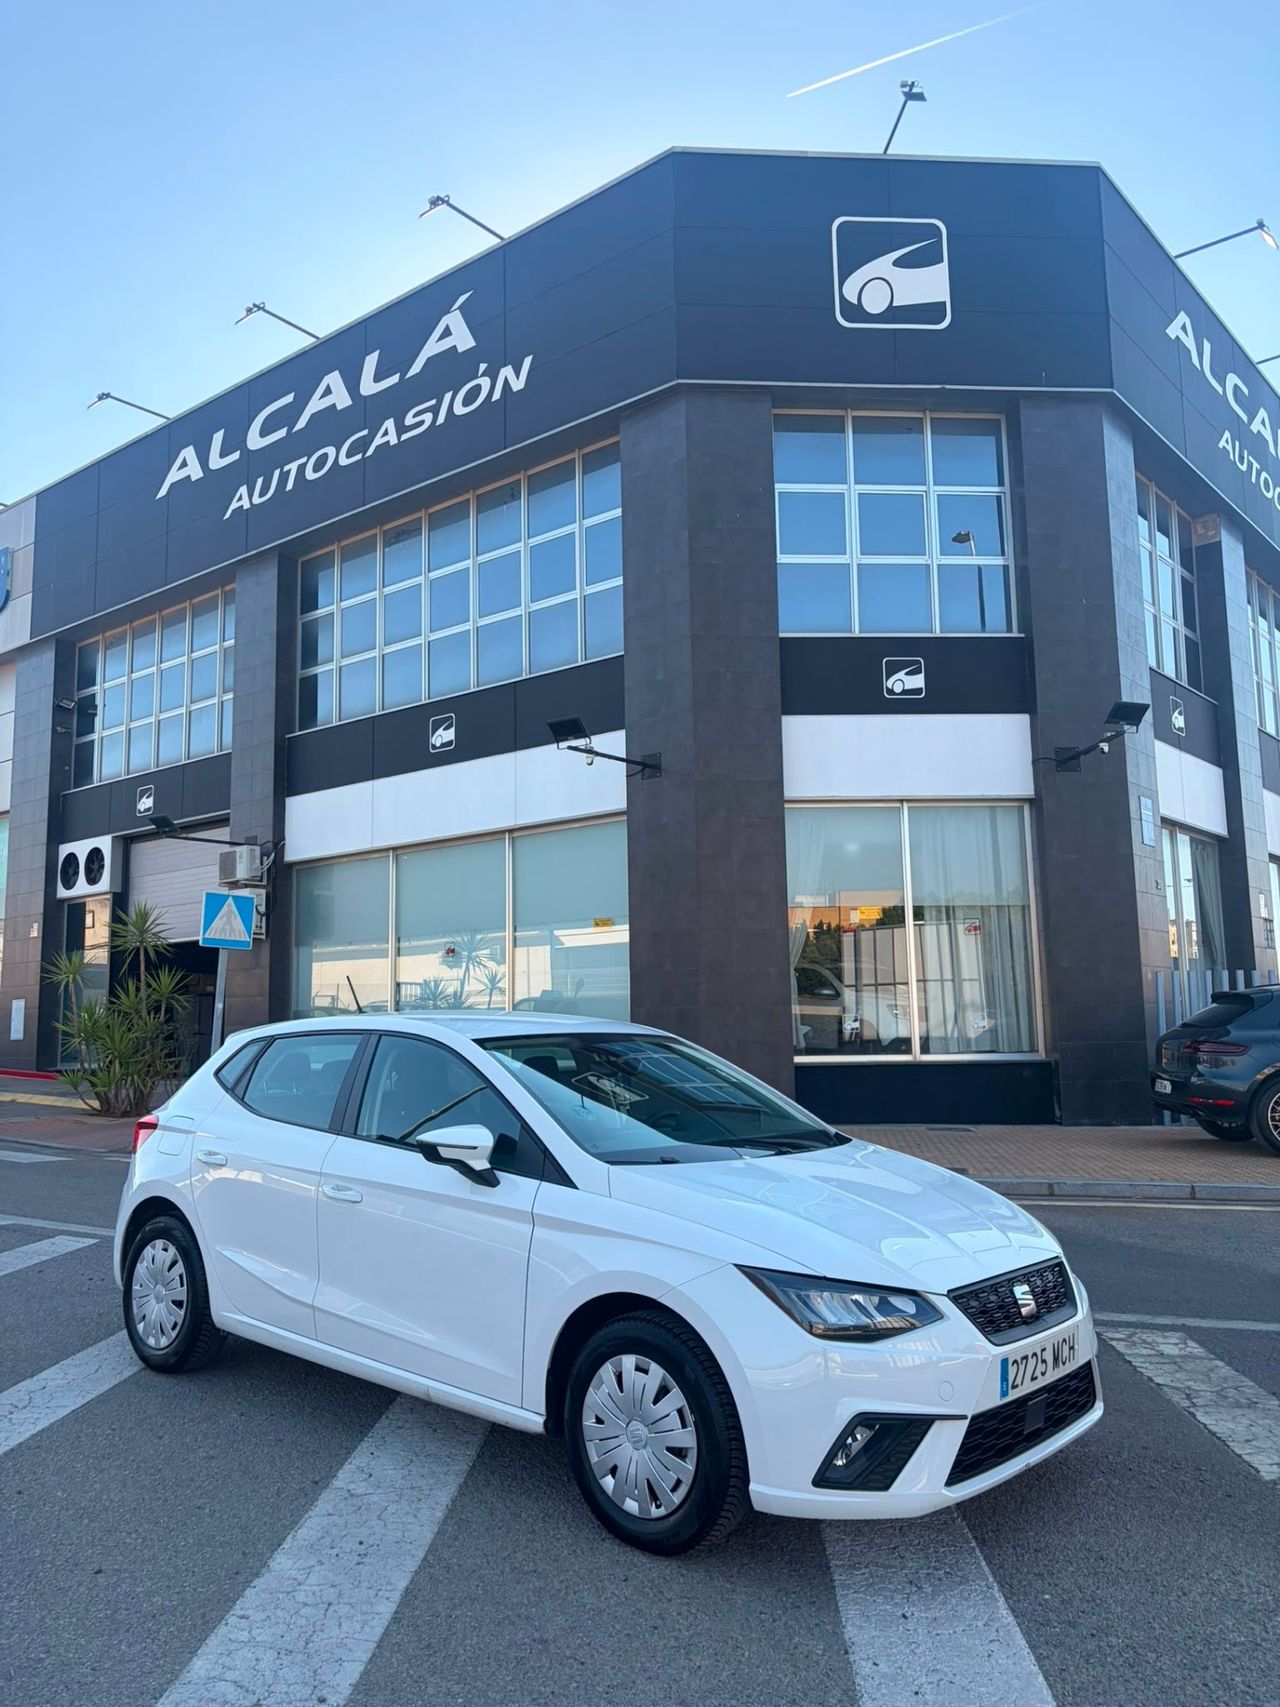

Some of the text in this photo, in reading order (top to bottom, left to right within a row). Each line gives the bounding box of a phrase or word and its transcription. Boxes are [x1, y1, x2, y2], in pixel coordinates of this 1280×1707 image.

[155, 290, 477, 500] ALCALÁ
[222, 354, 534, 521] AUTOCASIÓN
[1165, 310, 1280, 459] ALCA
[1011, 1332, 1075, 1390] 2725 MCH
